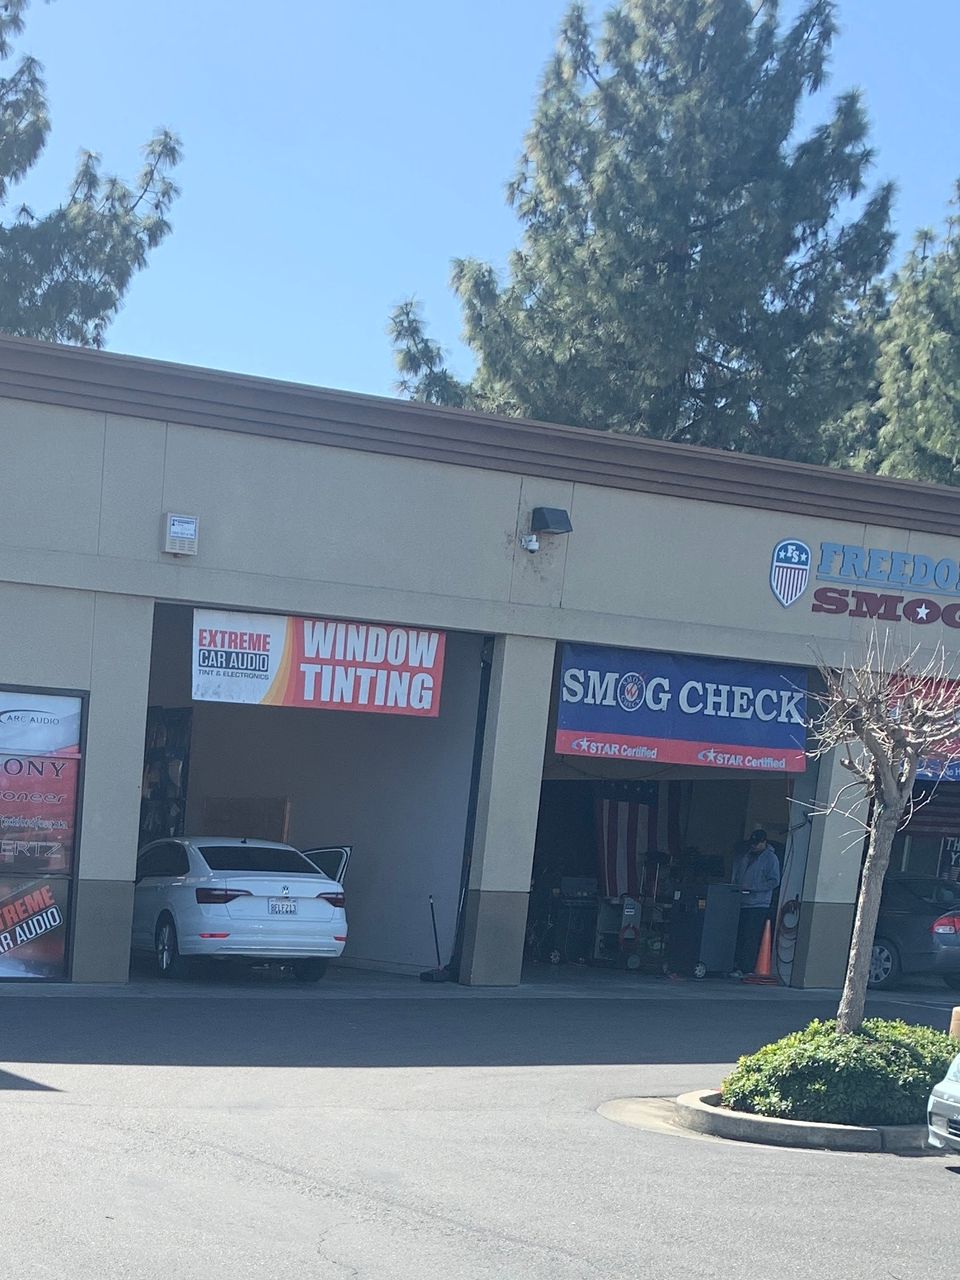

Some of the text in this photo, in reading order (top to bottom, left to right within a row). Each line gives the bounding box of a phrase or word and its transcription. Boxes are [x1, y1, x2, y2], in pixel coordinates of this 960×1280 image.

[816, 541, 960, 591] FREEDO
[198, 628, 271, 652] EXTREME
[303, 620, 440, 668] WINDOW
[200, 650, 269, 672] CAR AUDIO
[198, 669, 214, 677] TINT
[222, 670, 270, 681] ELECTRONICS
[300, 663, 434, 710] TINTING
[562, 668, 808, 724] SMOG CHECK
[6, 714, 60, 726] ARC AUDIO
[590, 742, 658, 760] STAR Certified
[716, 755, 786, 769] STAR Certified
[14, 907, 61, 945] AUDIO
